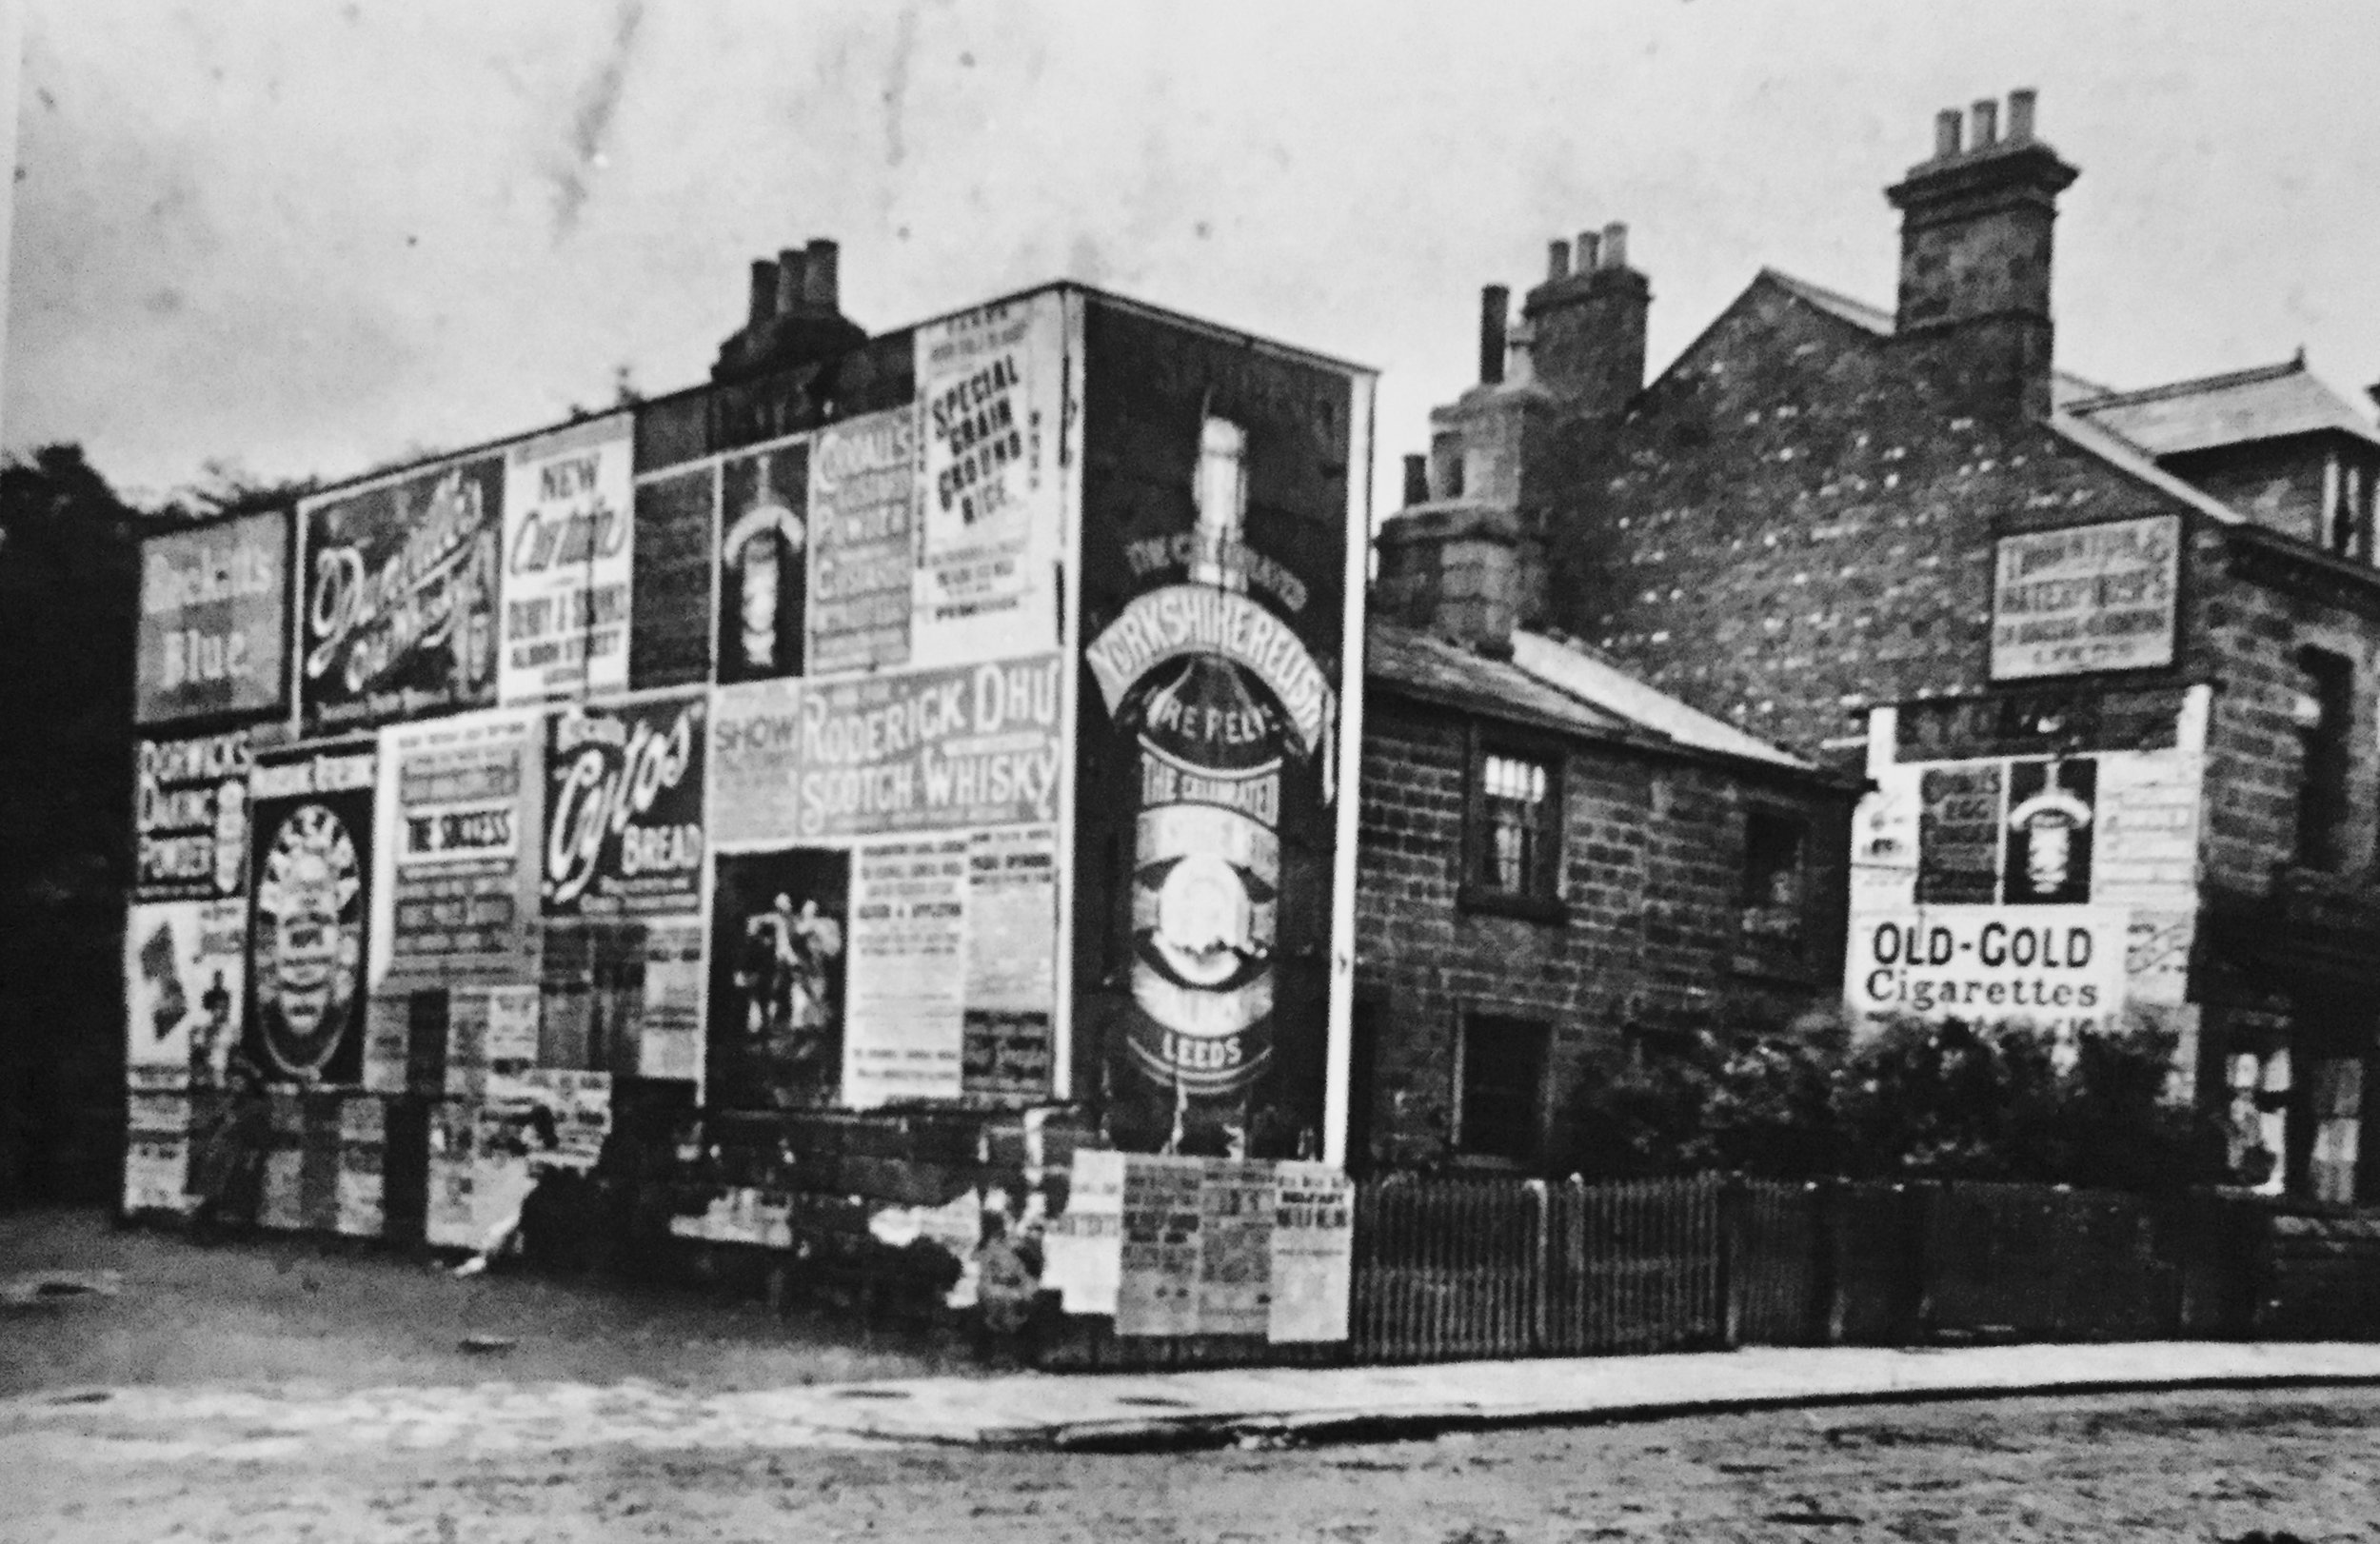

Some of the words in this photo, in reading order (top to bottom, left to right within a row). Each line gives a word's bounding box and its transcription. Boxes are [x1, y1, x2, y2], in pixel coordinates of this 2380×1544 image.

[932, 353, 1020, 441] SPECIAL
[939, 429, 1022, 513] GROUND
[160, 630, 252, 690] Blue
[1089, 590, 1255, 687] YORKSHIRE
[1253, 614, 1325, 735] RELISH
[803, 681, 966, 762] RODERICK
[974, 661, 1058, 734] DHU
[802, 760, 912, 835] SCOTCH
[922, 739, 1059, 819] WHISKY
[622, 823, 704, 876] BREAD
[1866, 968, 2097, 1012] Cigarettes
[1162, 1034, 1242, 1069] LEEDS
